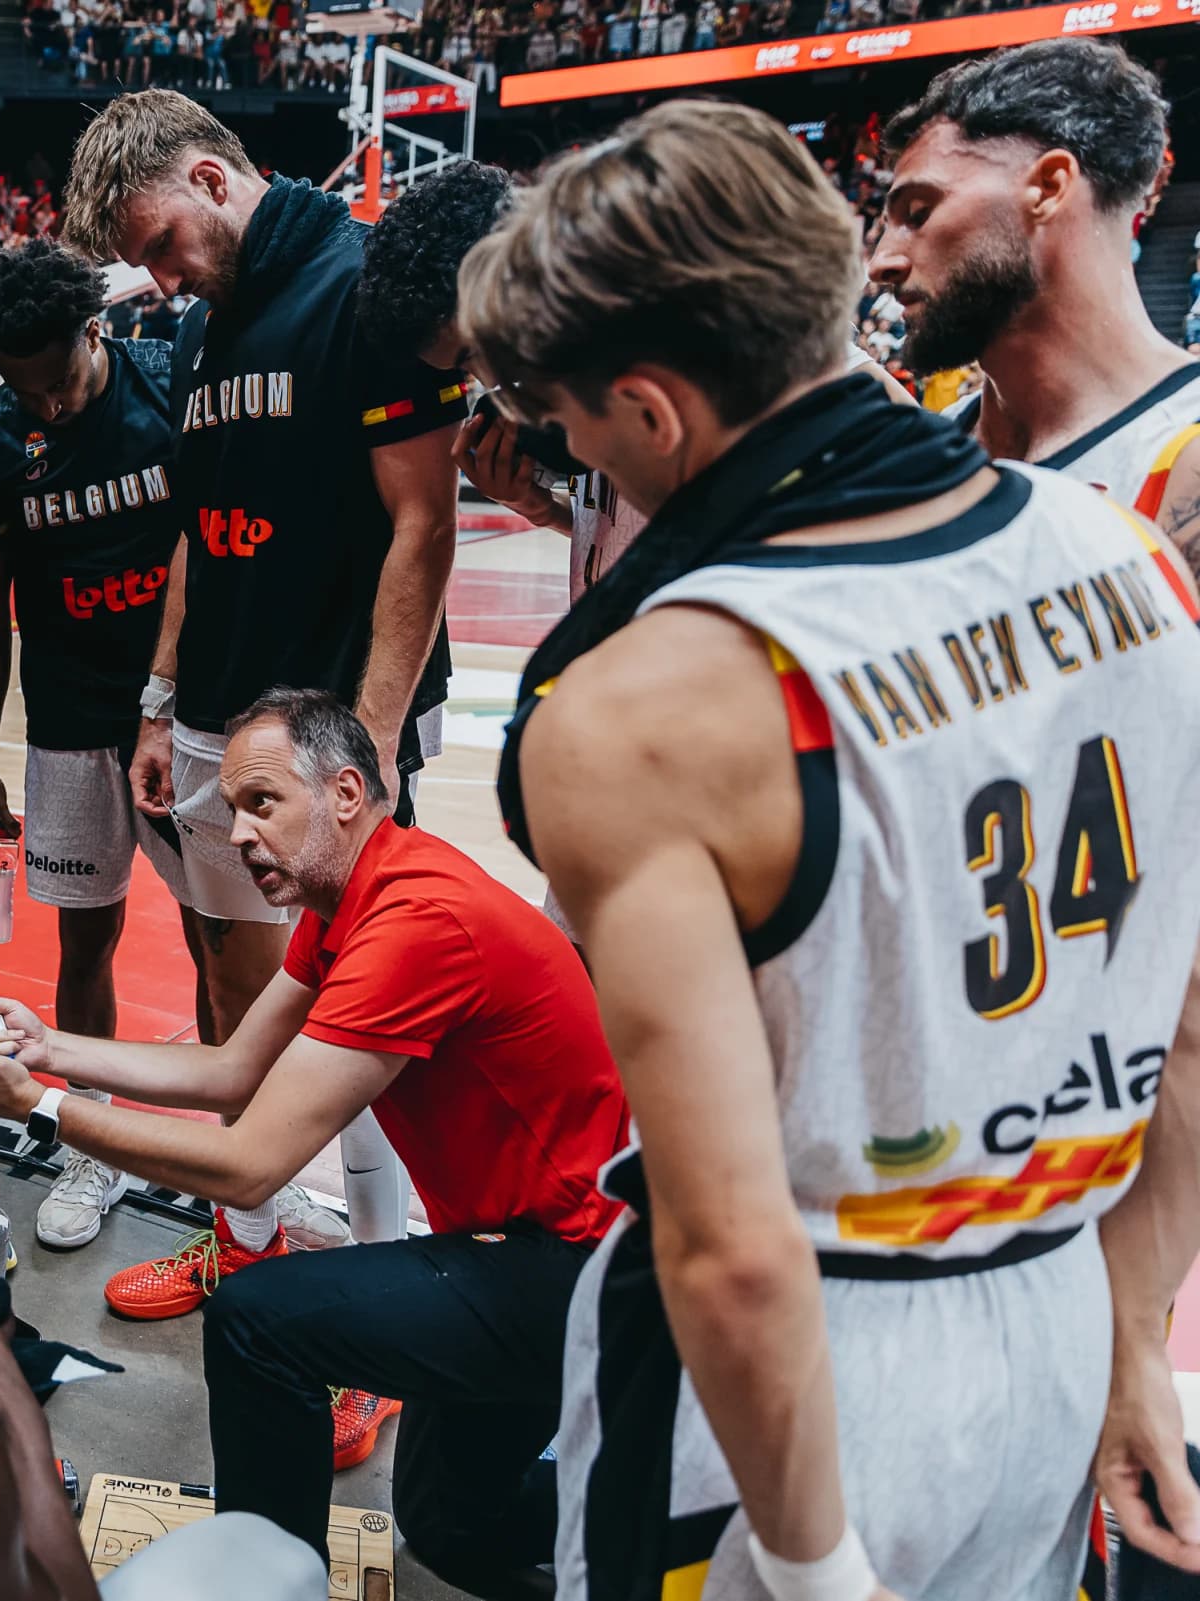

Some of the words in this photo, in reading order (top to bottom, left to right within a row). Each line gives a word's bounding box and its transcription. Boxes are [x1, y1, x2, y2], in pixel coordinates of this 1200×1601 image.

[23, 465, 170, 531] BELGIUM
[62, 566, 168, 619] lotto
[833, 646, 952, 746] VAN
[940, 613, 1029, 711] DEN
[26, 850, 100, 876] Deloitte.
[964, 735, 1144, 1021] 34
